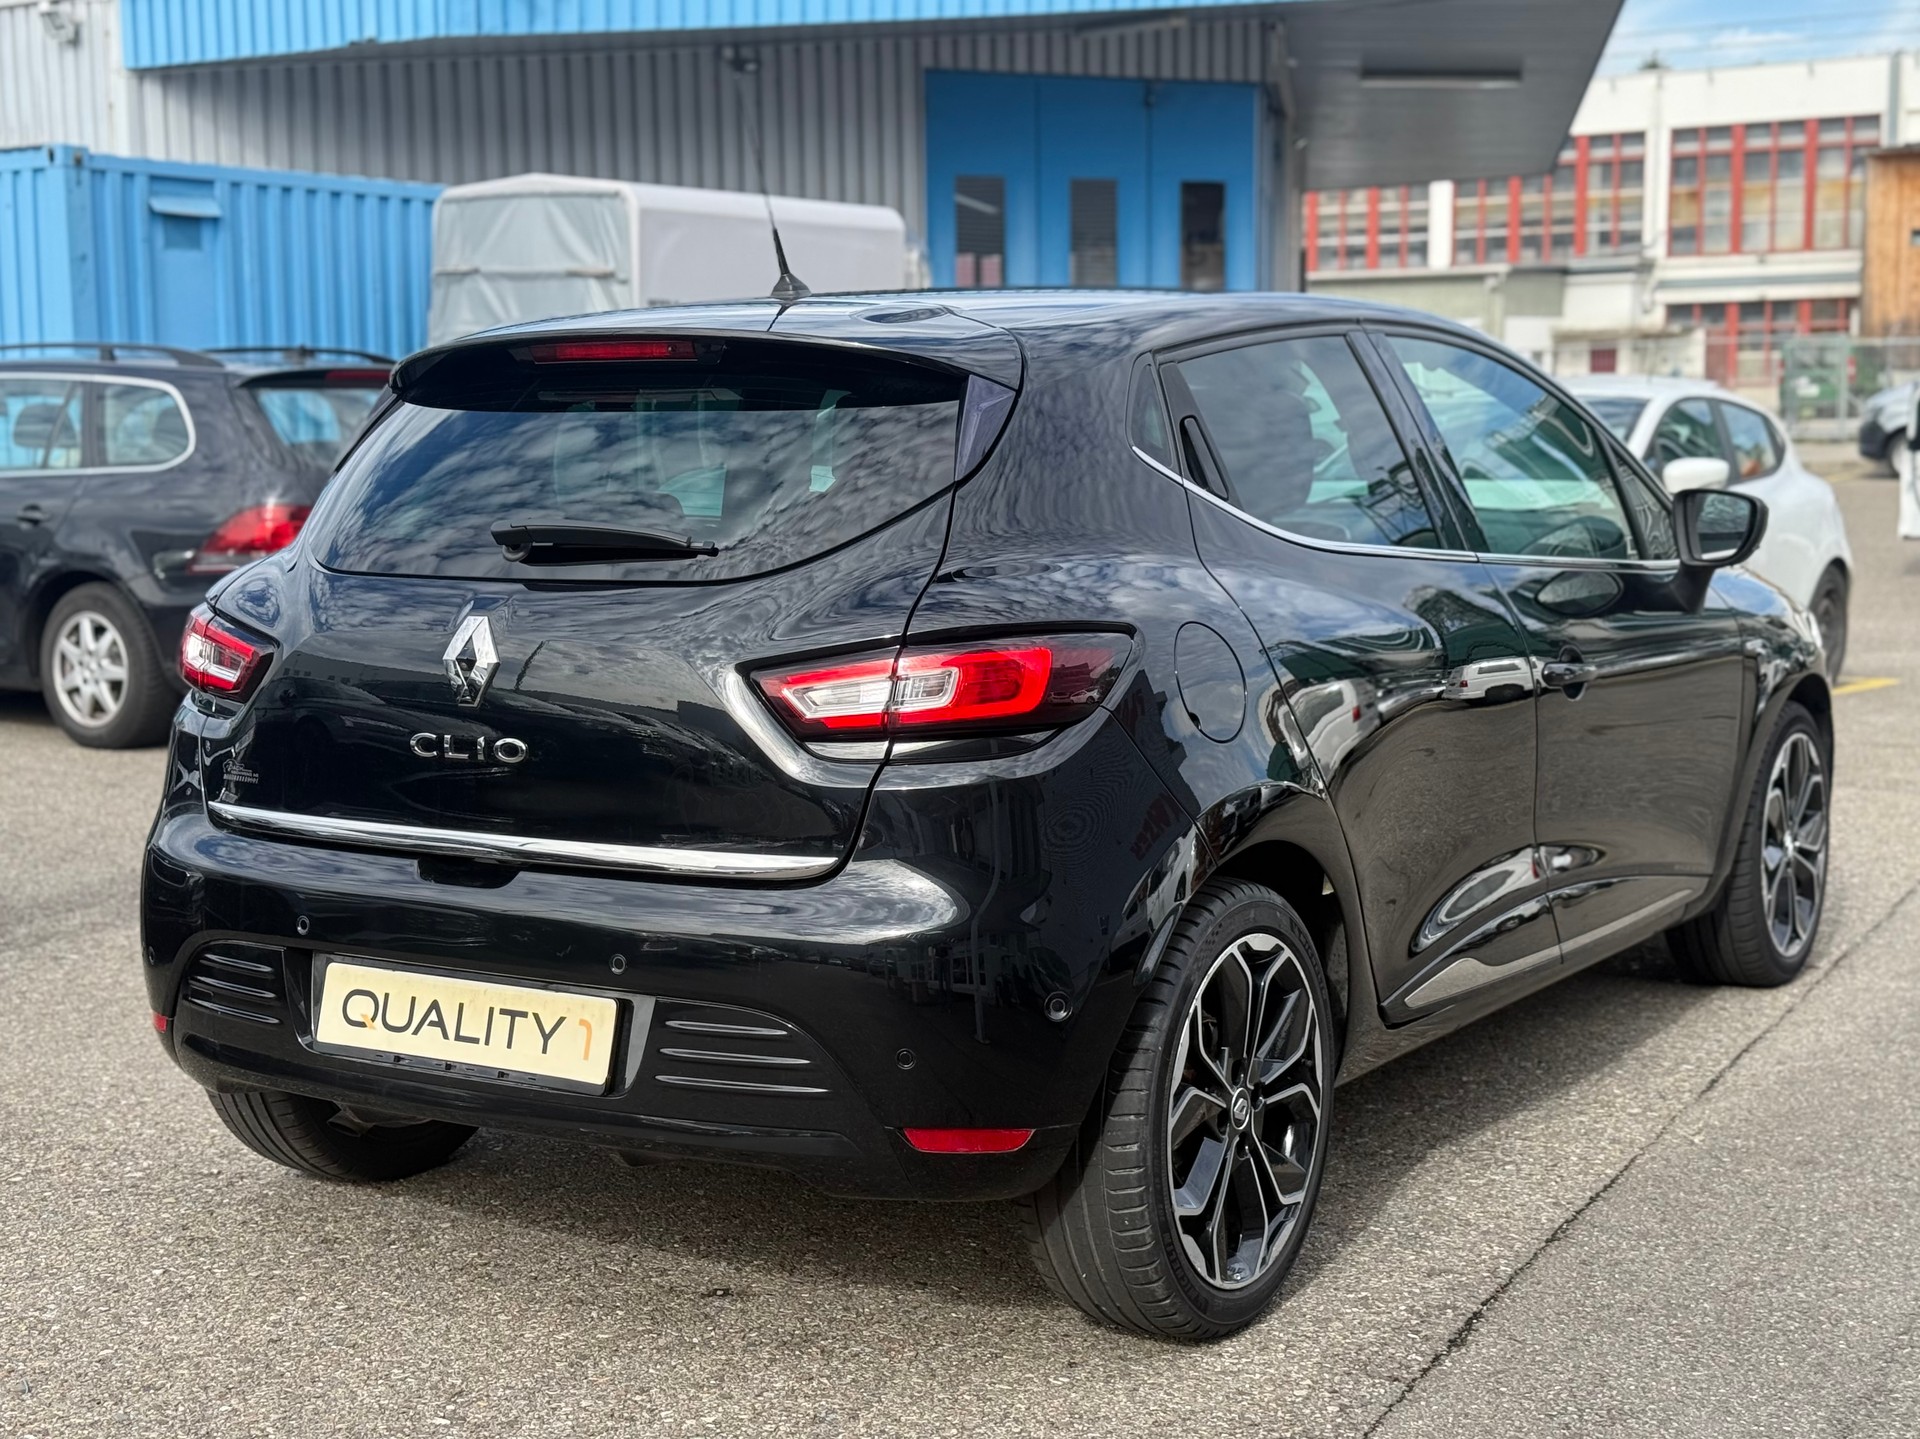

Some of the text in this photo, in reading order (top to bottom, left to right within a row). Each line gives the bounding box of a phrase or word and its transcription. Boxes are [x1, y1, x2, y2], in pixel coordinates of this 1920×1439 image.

[410, 733, 527, 763] CLIO
[342, 989, 593, 1061] QUALITY 1
